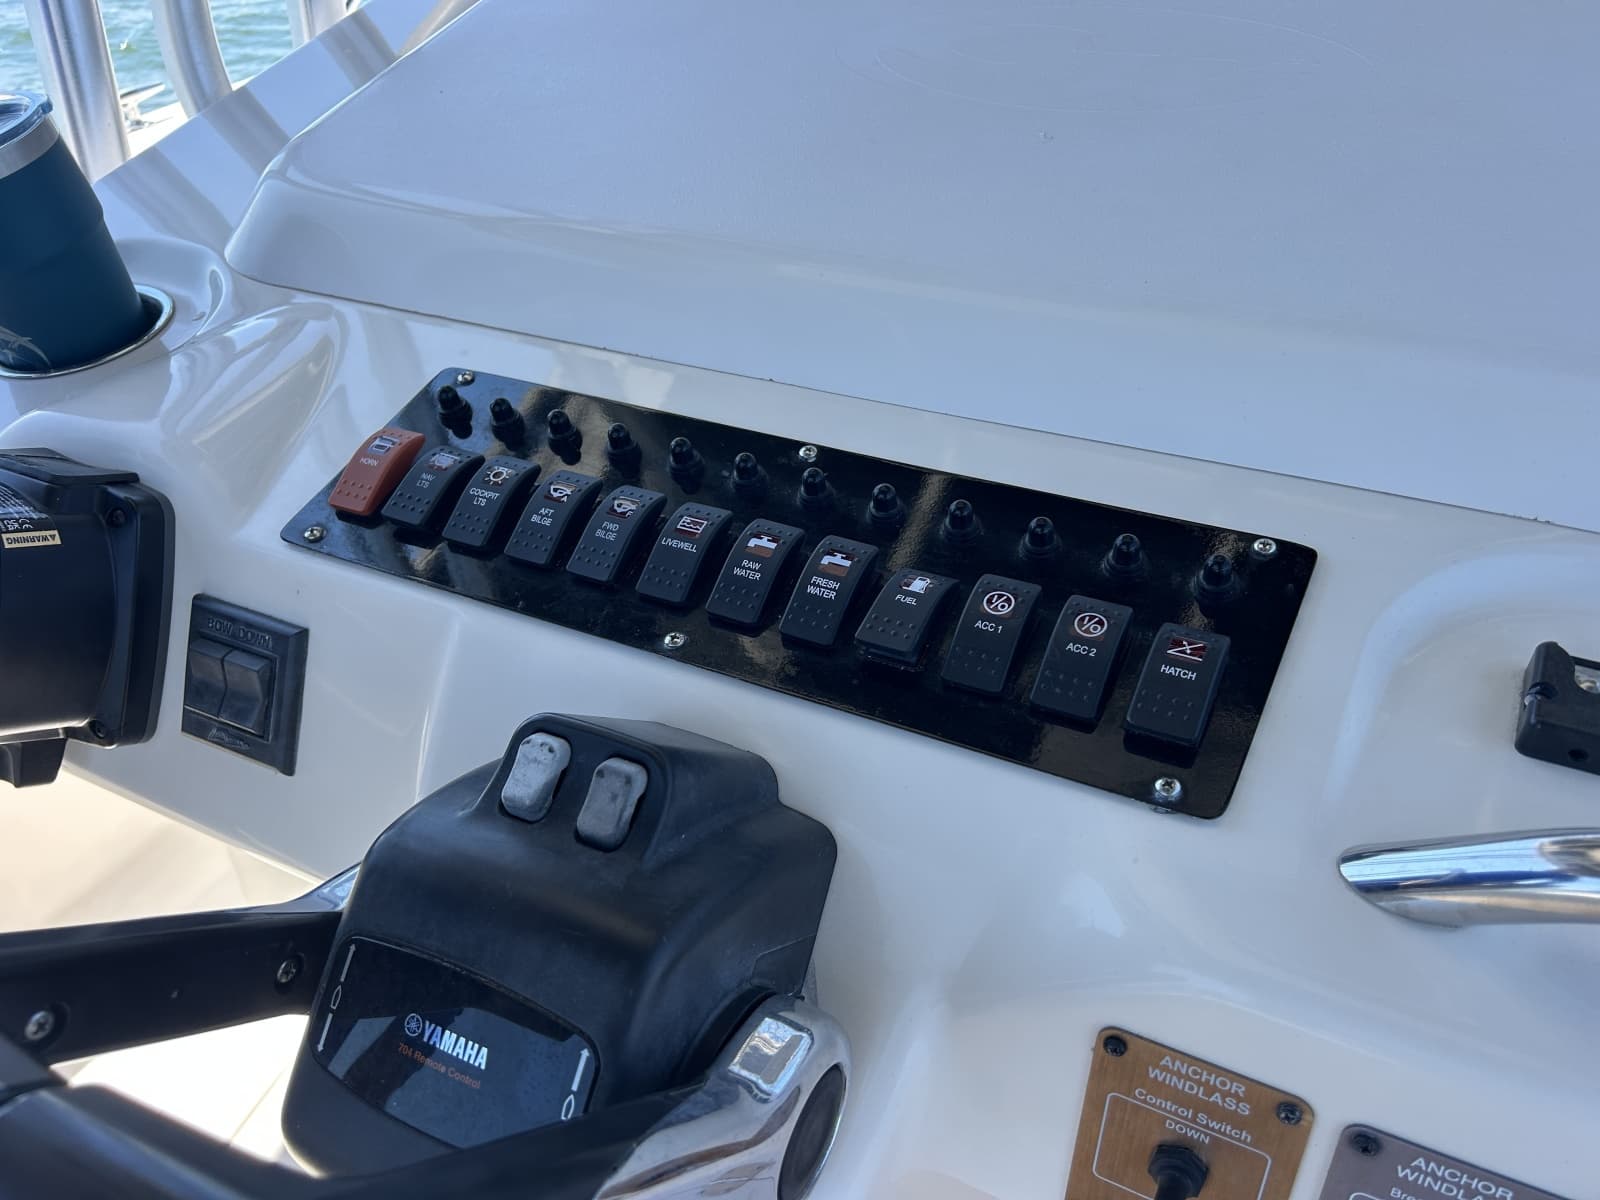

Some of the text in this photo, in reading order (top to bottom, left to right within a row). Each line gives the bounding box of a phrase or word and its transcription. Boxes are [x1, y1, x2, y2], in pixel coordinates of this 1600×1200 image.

[360, 457, 378, 467] HORN
[416, 480, 430, 488] LTS
[421, 472, 436, 481] NAV
[469, 487, 499, 500] COCKPIT
[473, 496, 486, 506] LTS
[538, 507, 555, 517] AFT
[531, 514, 553, 526] BILGE
[602, 521, 619, 532] FWD
[6, 534, 51, 545] WARNING
[595, 528, 617, 541] BILGE
[661, 537, 697, 553] LIVEWELL
[741, 559, 762, 570] RAW
[733, 566, 761, 581] WATER
[811, 575, 840, 590] FRESH
[807, 584, 836, 600] WATER
[895, 594, 917, 606] FUEL
[207, 617, 273, 650] BOW DOWN
[974, 619, 1002, 633] ACC 1
[1066, 642, 1097, 657] ACC 2
[1160, 664, 1197, 681] HATCH
[423, 1020, 488, 1070] YAMAHA
[414, 1050, 446, 1073] Remote
[447, 1067, 481, 1089] Control
[1160, 1055, 1246, 1098] ANCHOR
[1148, 1065, 1251, 1116] WINDLASS
[1135, 1088, 1252, 1143] Control Switch
[1165, 1119, 1210, 1145] DOWN
[1410, 1157, 1513, 1200] ANCHOR
